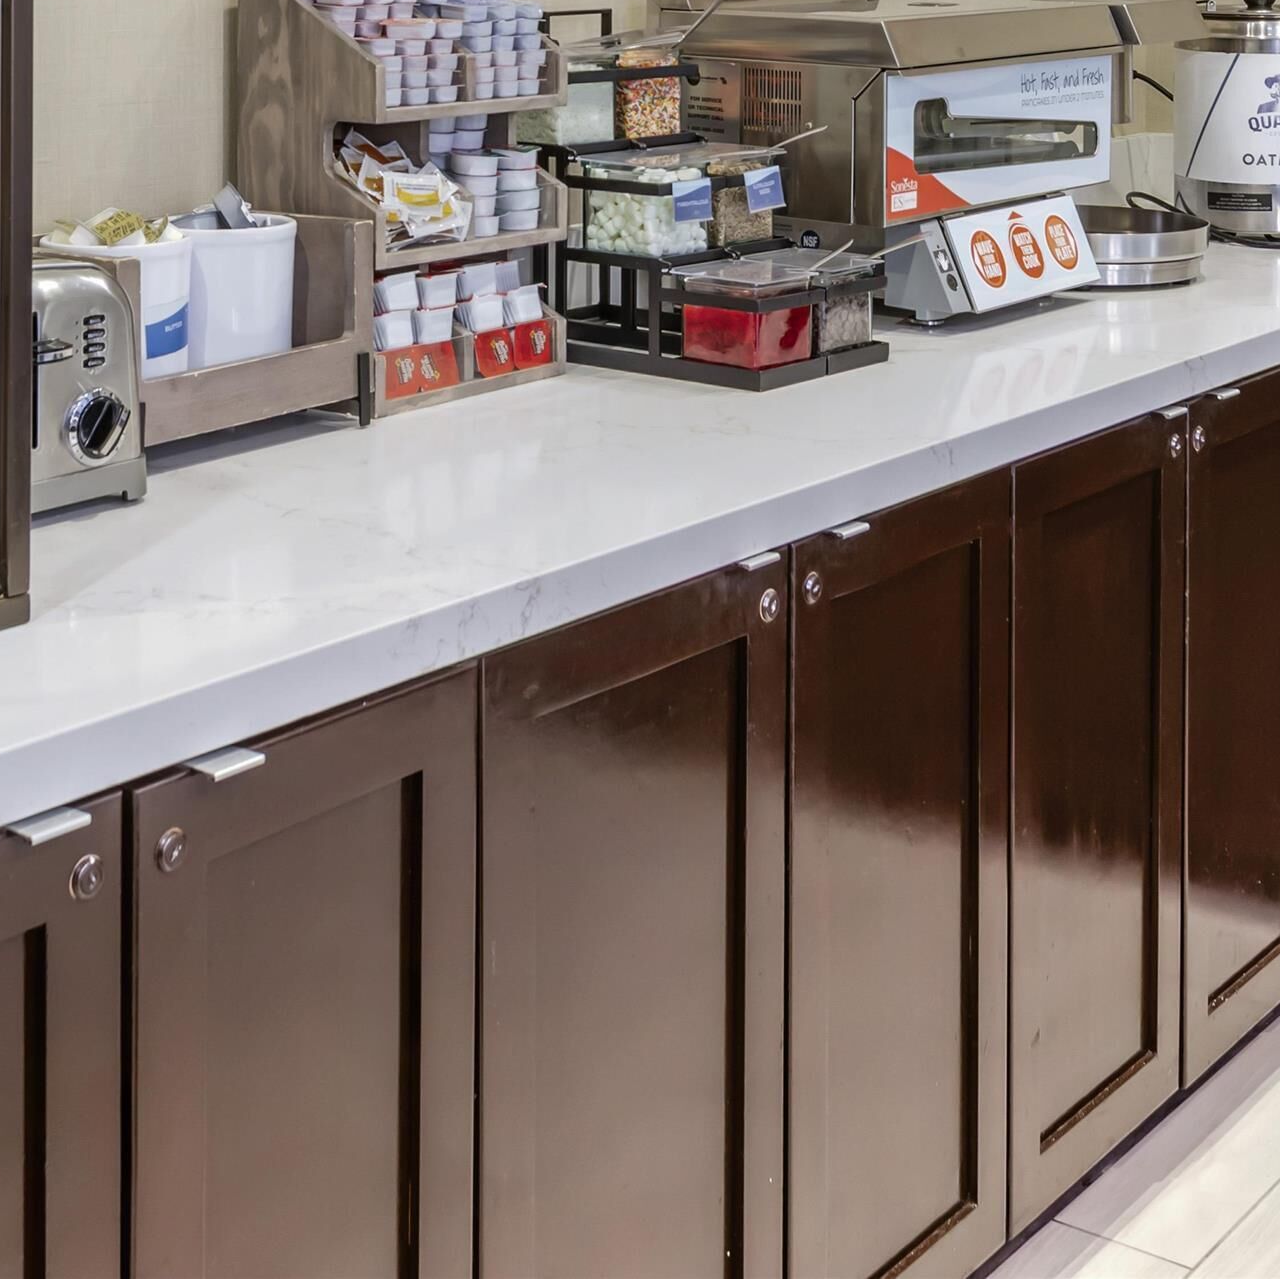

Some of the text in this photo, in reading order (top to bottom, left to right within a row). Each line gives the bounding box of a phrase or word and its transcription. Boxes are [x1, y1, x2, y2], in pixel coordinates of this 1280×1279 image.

[1020, 66, 1105, 96] Hot, Fast, and Fresh
[890, 177, 918, 194] Sonesta
[802, 235, 819, 247] NSF
